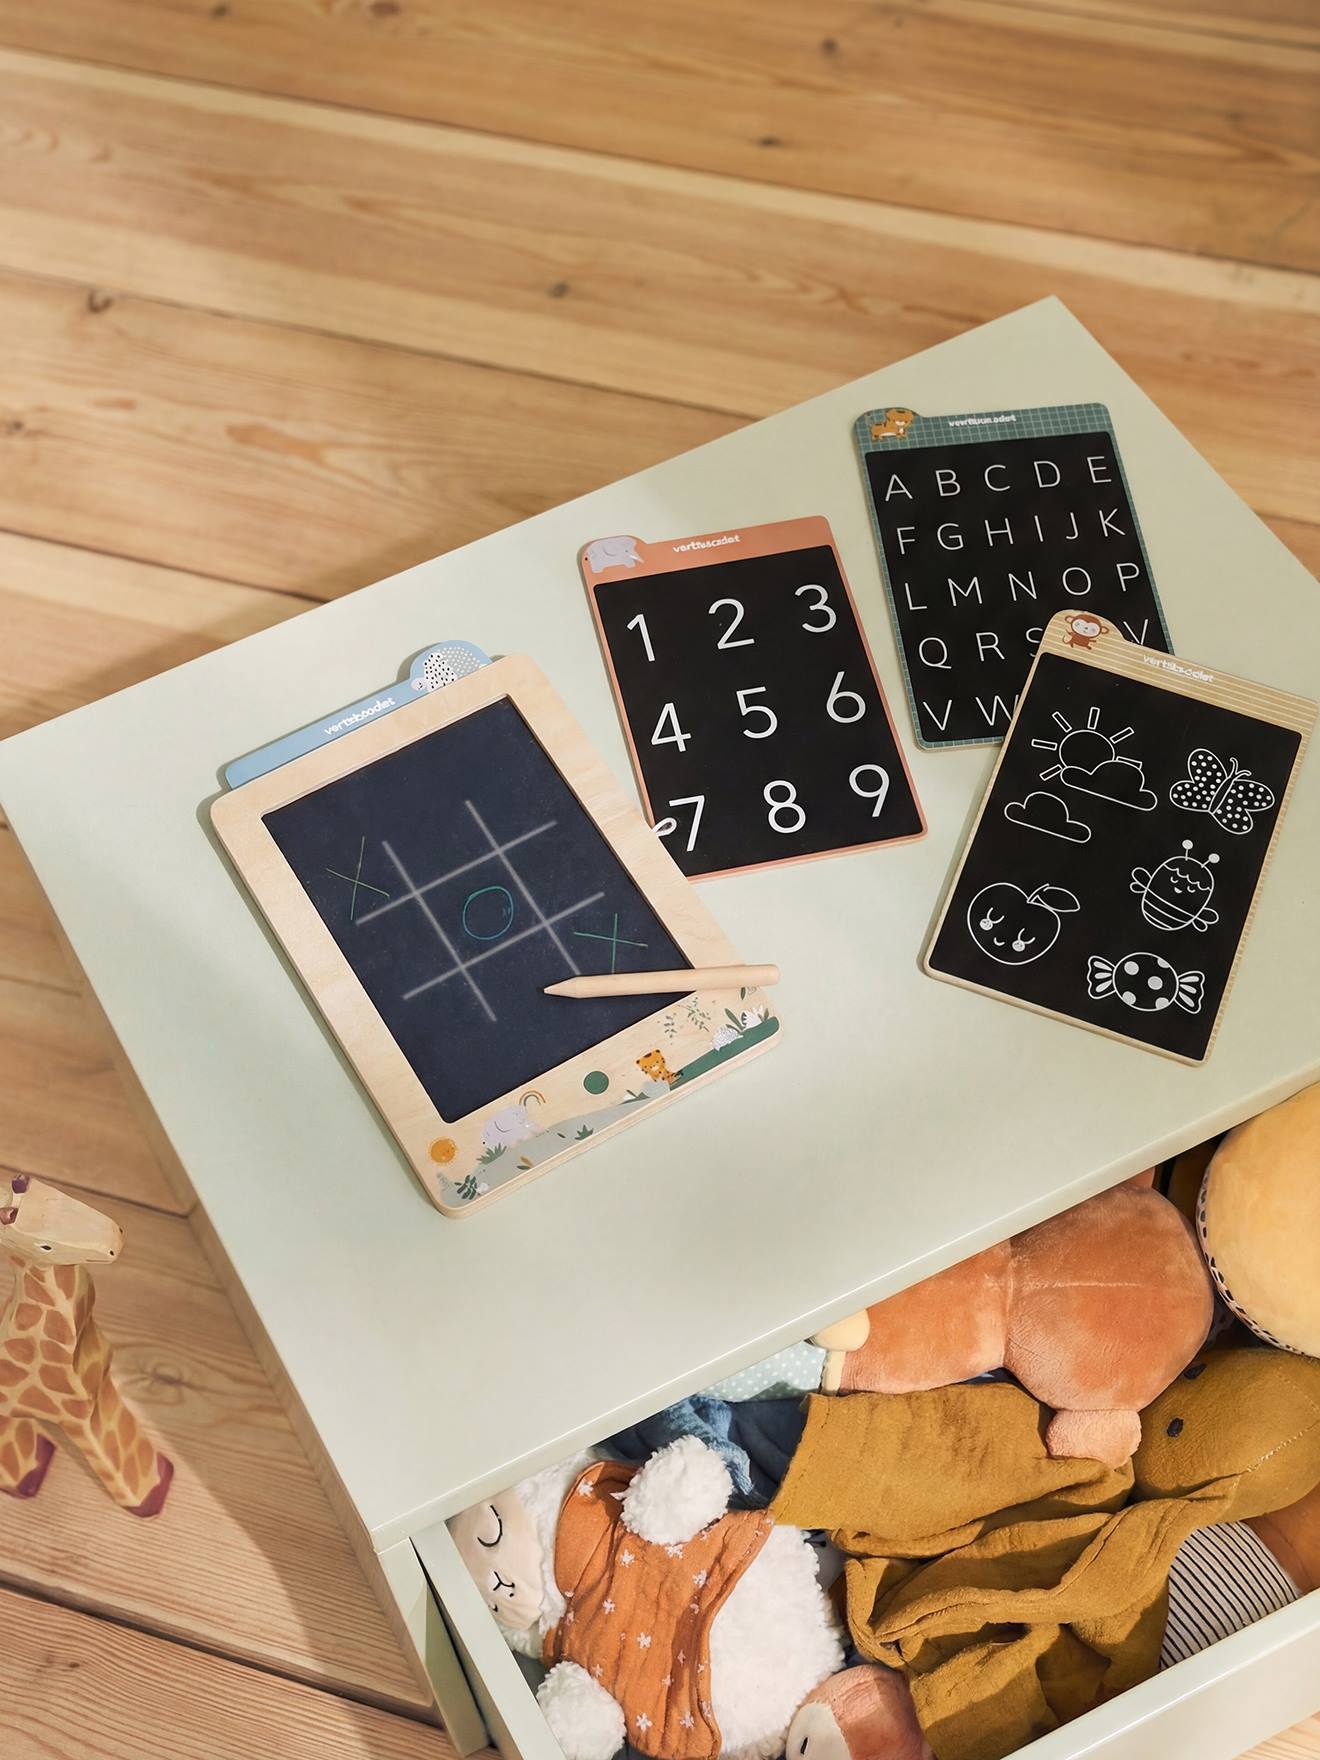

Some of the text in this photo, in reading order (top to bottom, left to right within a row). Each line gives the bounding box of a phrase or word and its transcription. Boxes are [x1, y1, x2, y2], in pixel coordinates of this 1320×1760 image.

[885, 455, 1112, 502] A B C D E
[896, 508, 1126, 555] F G H I J K
[904, 562, 1140, 611] L M N O P
[626, 584, 837, 662] 1 2 3
[918, 637, 952, 670] Q
[975, 631, 1005, 662] R
[650, 670, 866, 753] 4 5 6
[922, 694, 1020, 731] V W
[668, 763, 890, 853] 7 8 9
